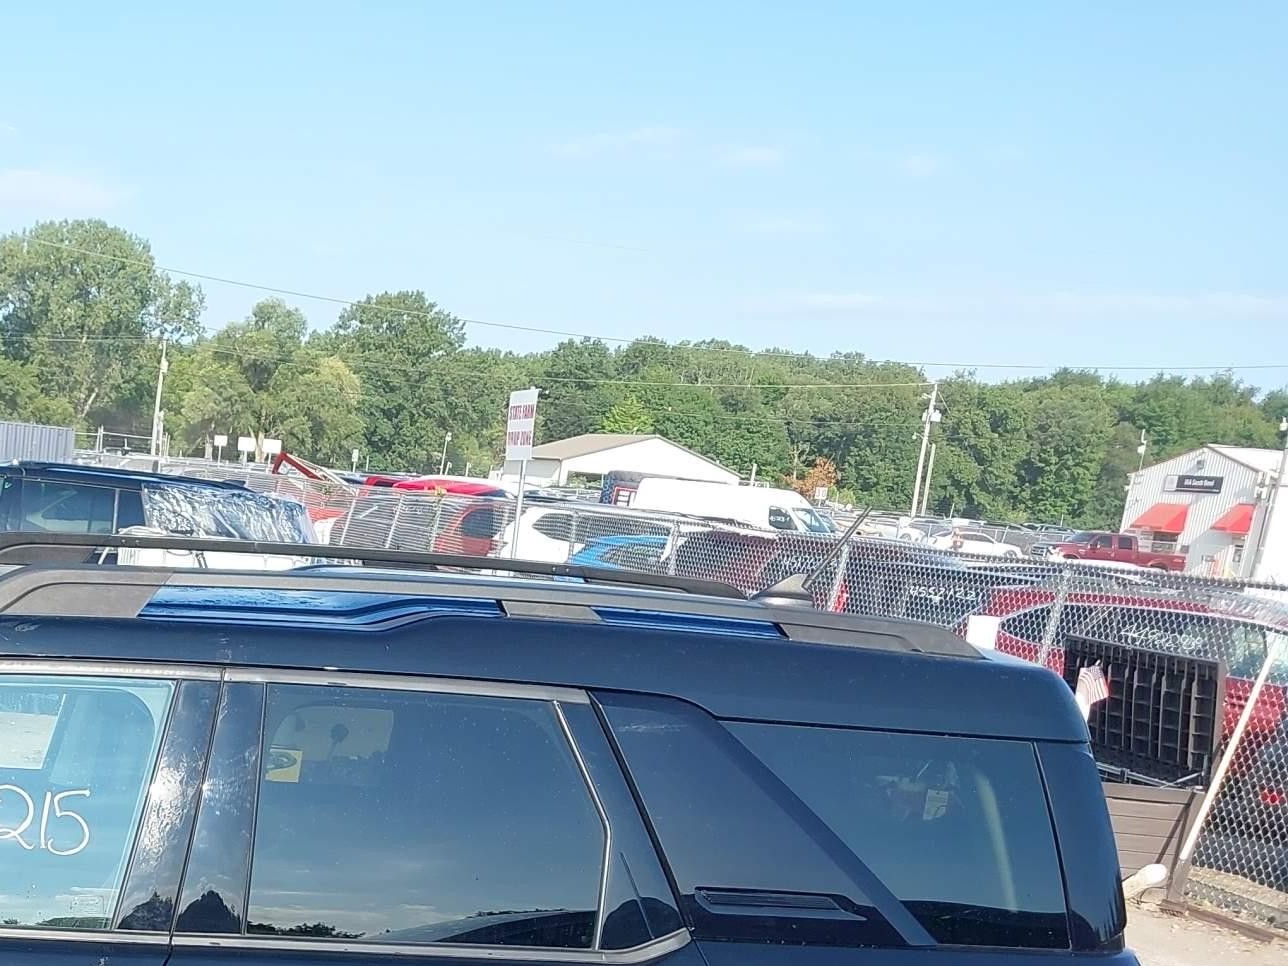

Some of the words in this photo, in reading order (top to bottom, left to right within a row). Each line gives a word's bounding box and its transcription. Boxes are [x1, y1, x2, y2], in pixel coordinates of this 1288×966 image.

[509, 405, 522, 420] STATE
[522, 403, 535, 419] FARM
[520, 430, 532, 446] ZONE
